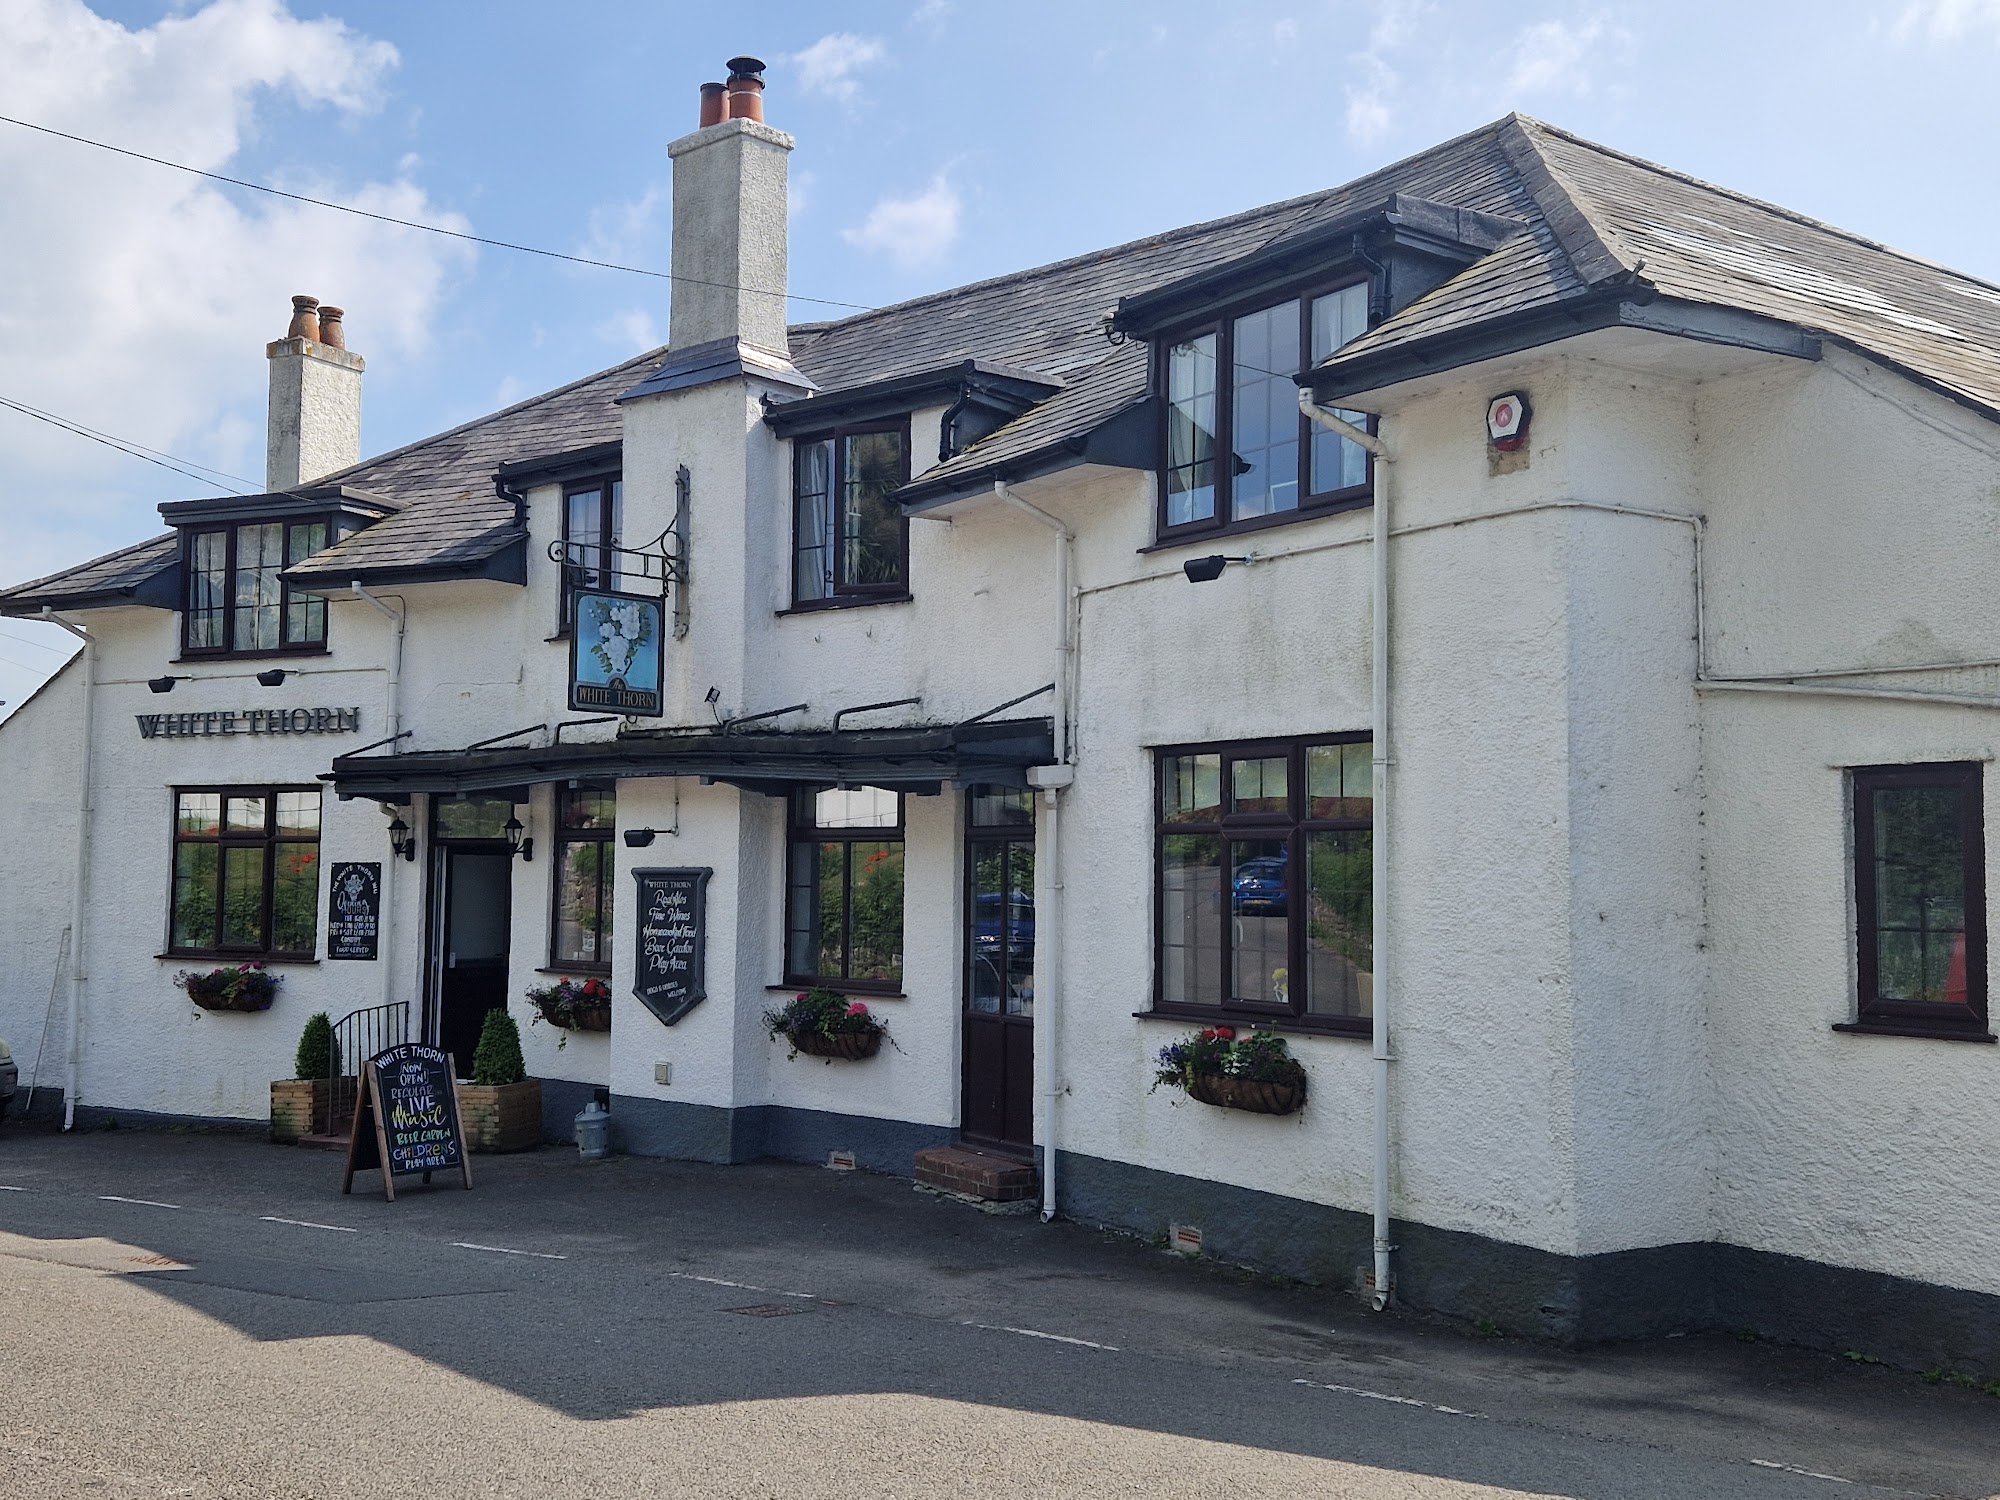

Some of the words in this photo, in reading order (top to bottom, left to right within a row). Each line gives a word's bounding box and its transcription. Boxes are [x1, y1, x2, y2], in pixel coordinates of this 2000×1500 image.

[579, 687, 611, 704] WHITE
[617, 690, 654, 707] THORN
[134, 711, 235, 739] WHITE
[242, 706, 360, 737] THORN
[332, 881, 340, 893] THE
[337, 864, 353, 880] WHITE
[357, 864, 374, 881] THORN
[648, 907, 665, 921] Fine
[667, 907, 691, 923] Wines
[644, 936, 665, 955] Beer
[667, 938, 693, 957] Garden
[649, 953, 669, 974] Play
[670, 955, 687, 972] Area
[375, 1047, 407, 1069] WHITE
[411, 1046, 445, 1063] THORN
[402, 1062, 422, 1073] NOW
[400, 1070, 427, 1086] OPEN!
[391, 1085, 434, 1099] REGULAR
[398, 1094, 436, 1116] LIVE
[396, 1131, 418, 1145] BEER
[420, 1128, 451, 1142] GARDEN
[405, 1158, 424, 1169] PLAY
[426, 1155, 446, 1165] AREA
